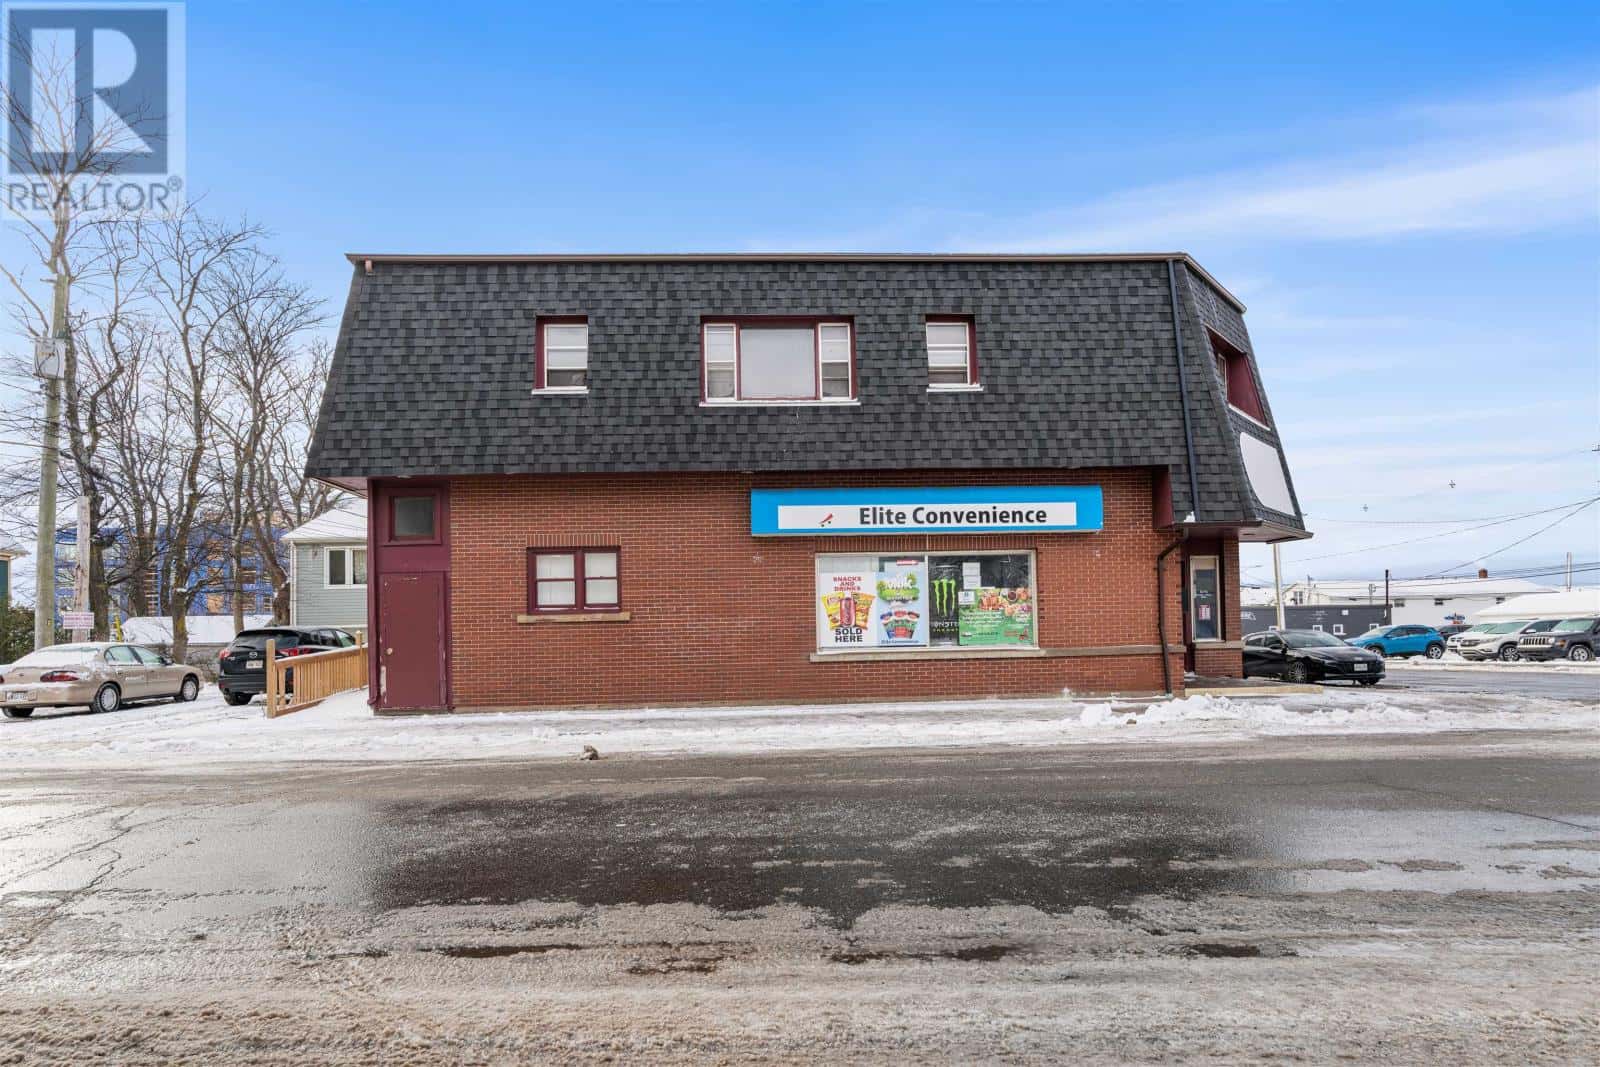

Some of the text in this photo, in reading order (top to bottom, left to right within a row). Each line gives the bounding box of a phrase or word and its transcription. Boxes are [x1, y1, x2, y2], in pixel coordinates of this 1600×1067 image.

[859, 505, 1047, 525] Elite Convenience
[835, 628, 863, 636] SOLD
[835, 635, 863, 643] HERE
